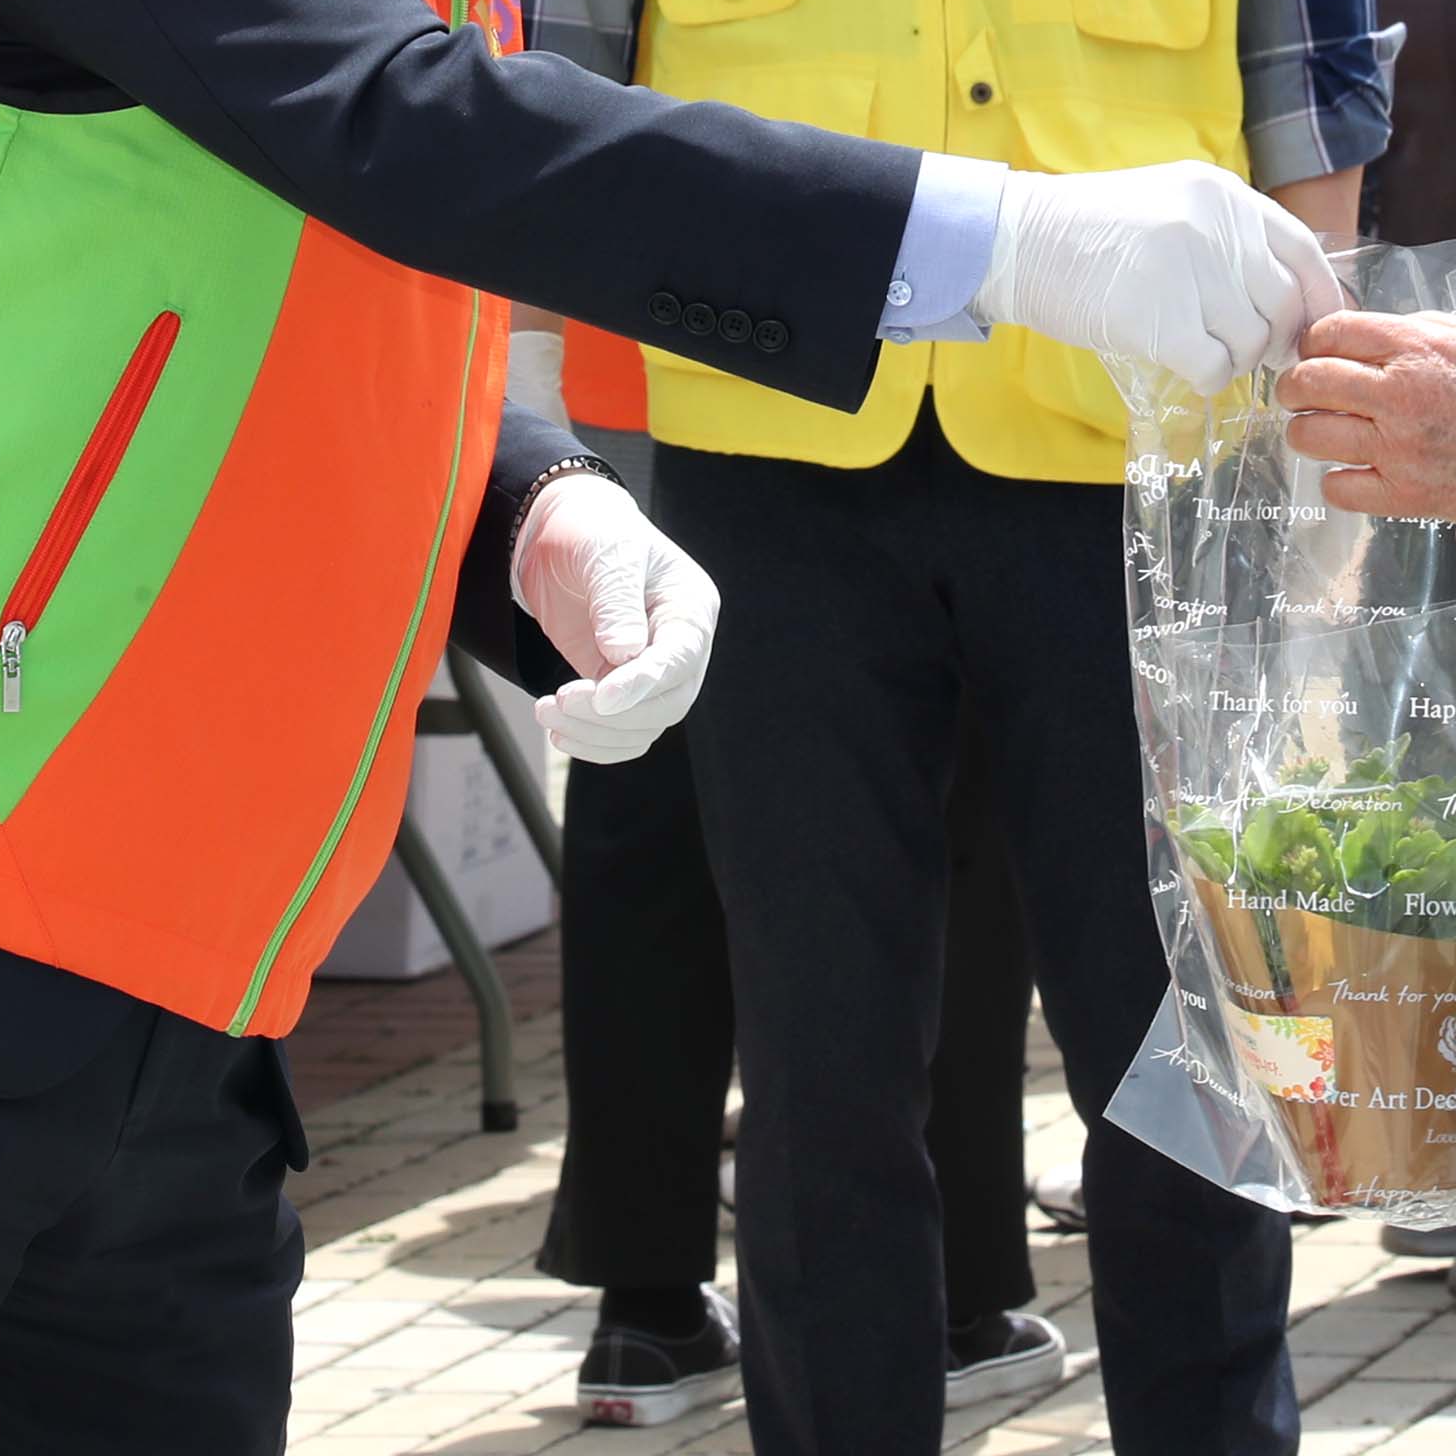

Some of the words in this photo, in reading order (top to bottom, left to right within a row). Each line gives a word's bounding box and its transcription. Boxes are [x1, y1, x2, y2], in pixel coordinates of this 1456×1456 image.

[1192, 497, 1254, 522] Thank
[1255, 498, 1283, 520] for
[1288, 505, 1328, 527] you
[1153, 594, 1228, 618] coration
[1264, 590, 1326, 618] Thank
[1333, 597, 1364, 619] for
[1367, 604, 1408, 626] you
[1209, 690, 1277, 714] Thank
[1281, 691, 1311, 714] for
[1320, 696, 1358, 719] you
[1276, 790, 1404, 815] Decoration
[1227, 888, 1288, 911] Hand
[1294, 890, 1356, 913] Made
[1179, 988, 1208, 1011] you
[1327, 978, 1390, 1006] Thank
[1396, 984, 1427, 1006] for
[1367, 1086, 1408, 1110] Art
